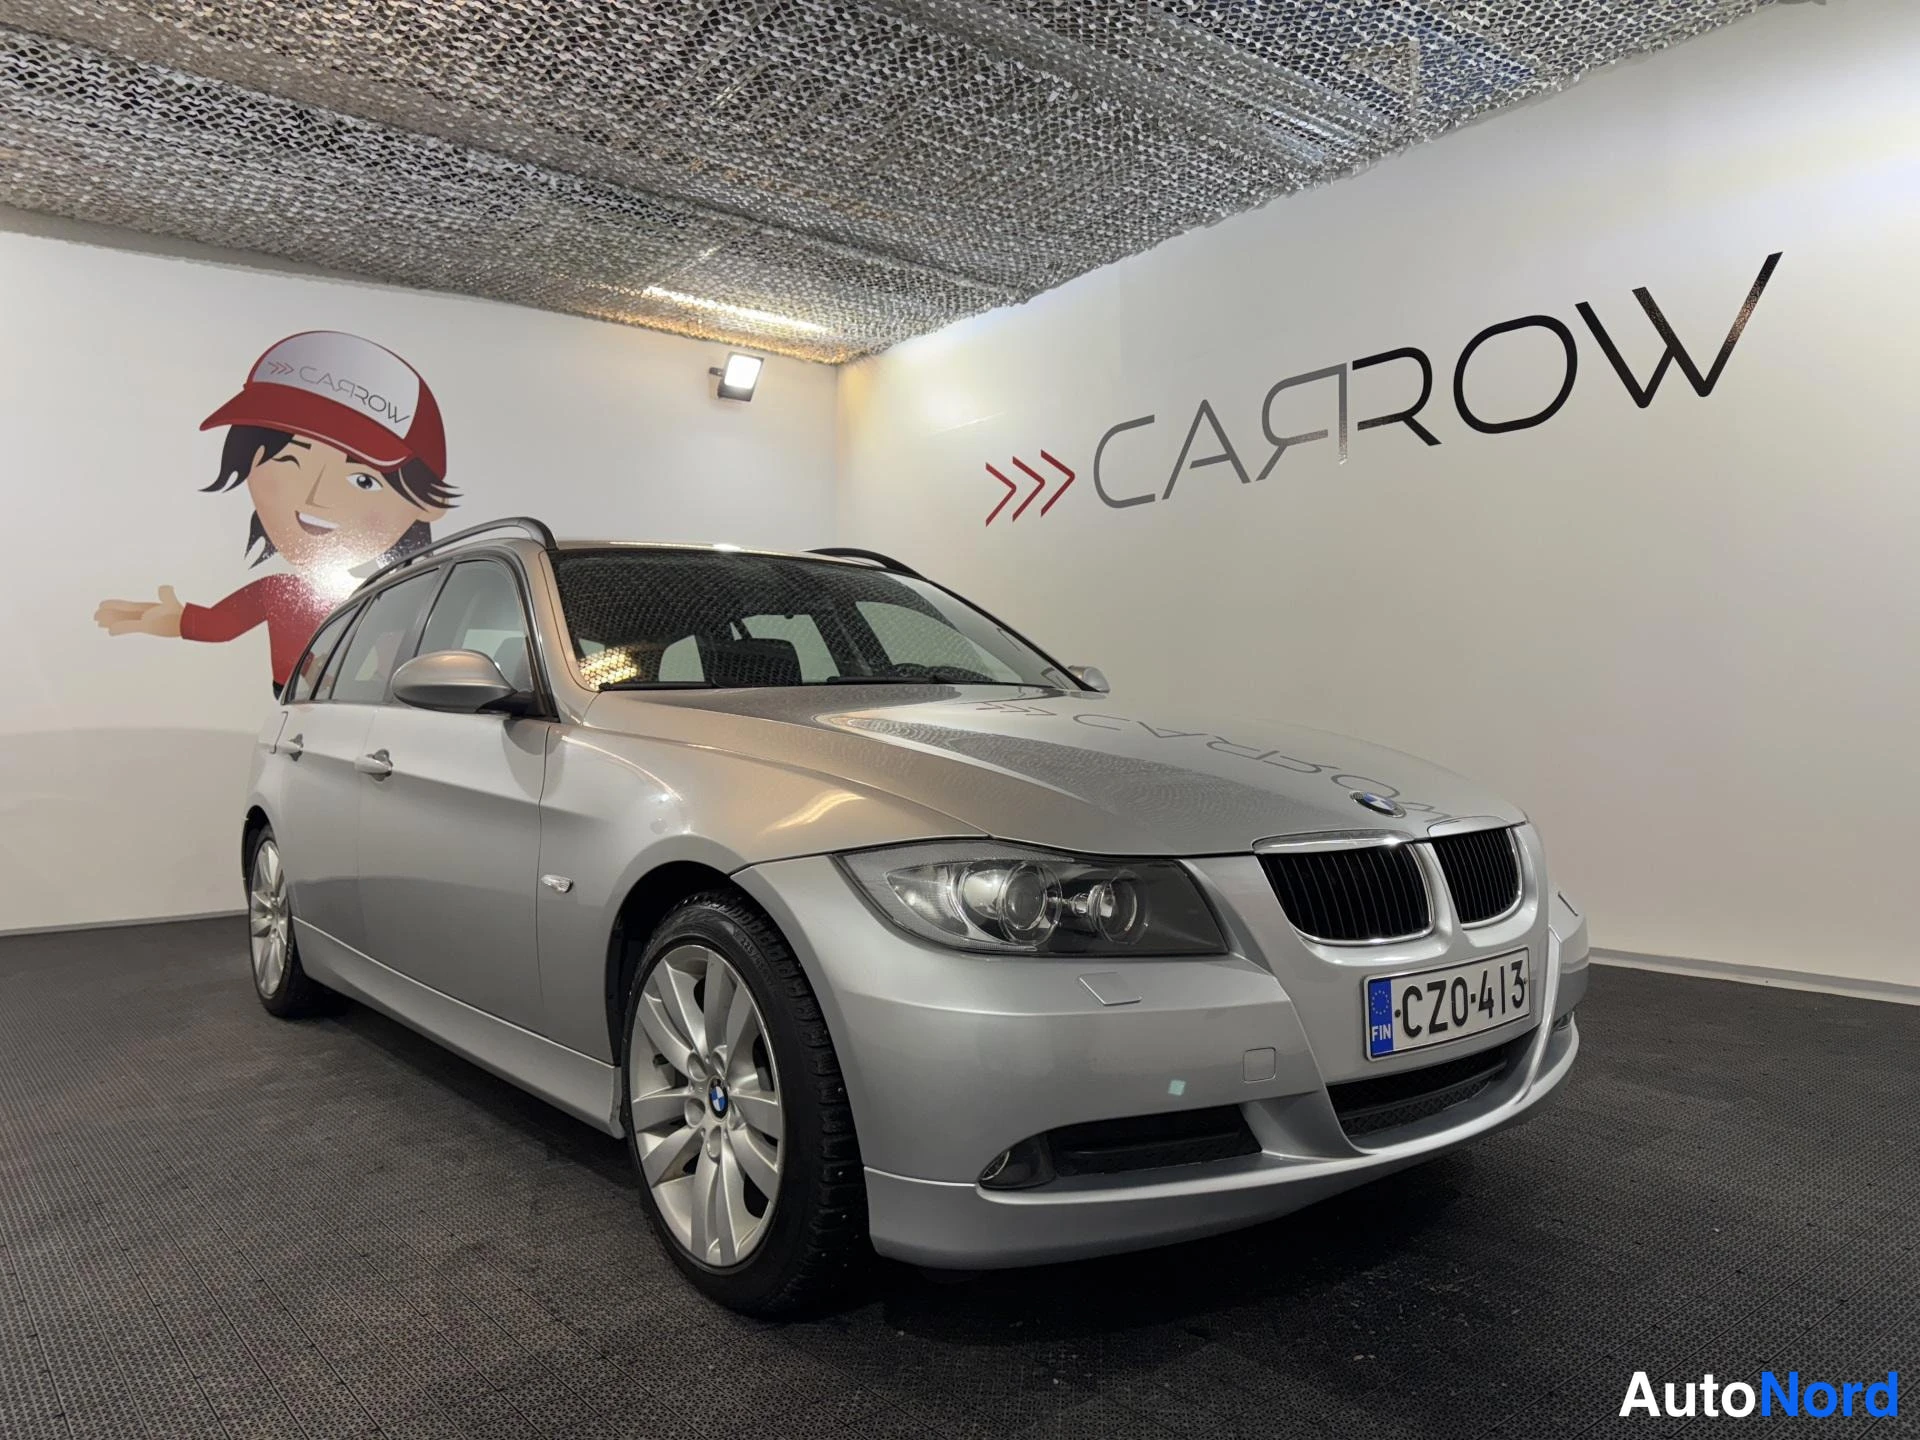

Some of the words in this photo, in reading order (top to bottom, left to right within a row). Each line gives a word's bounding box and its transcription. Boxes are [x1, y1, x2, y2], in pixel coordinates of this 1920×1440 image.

[299, 366, 410, 424] CARROW
[1093, 251, 1784, 509] CARROW
[1371, 1024, 1391, 1042] FIN
[1402, 960, 1525, 1038] CZO-413
